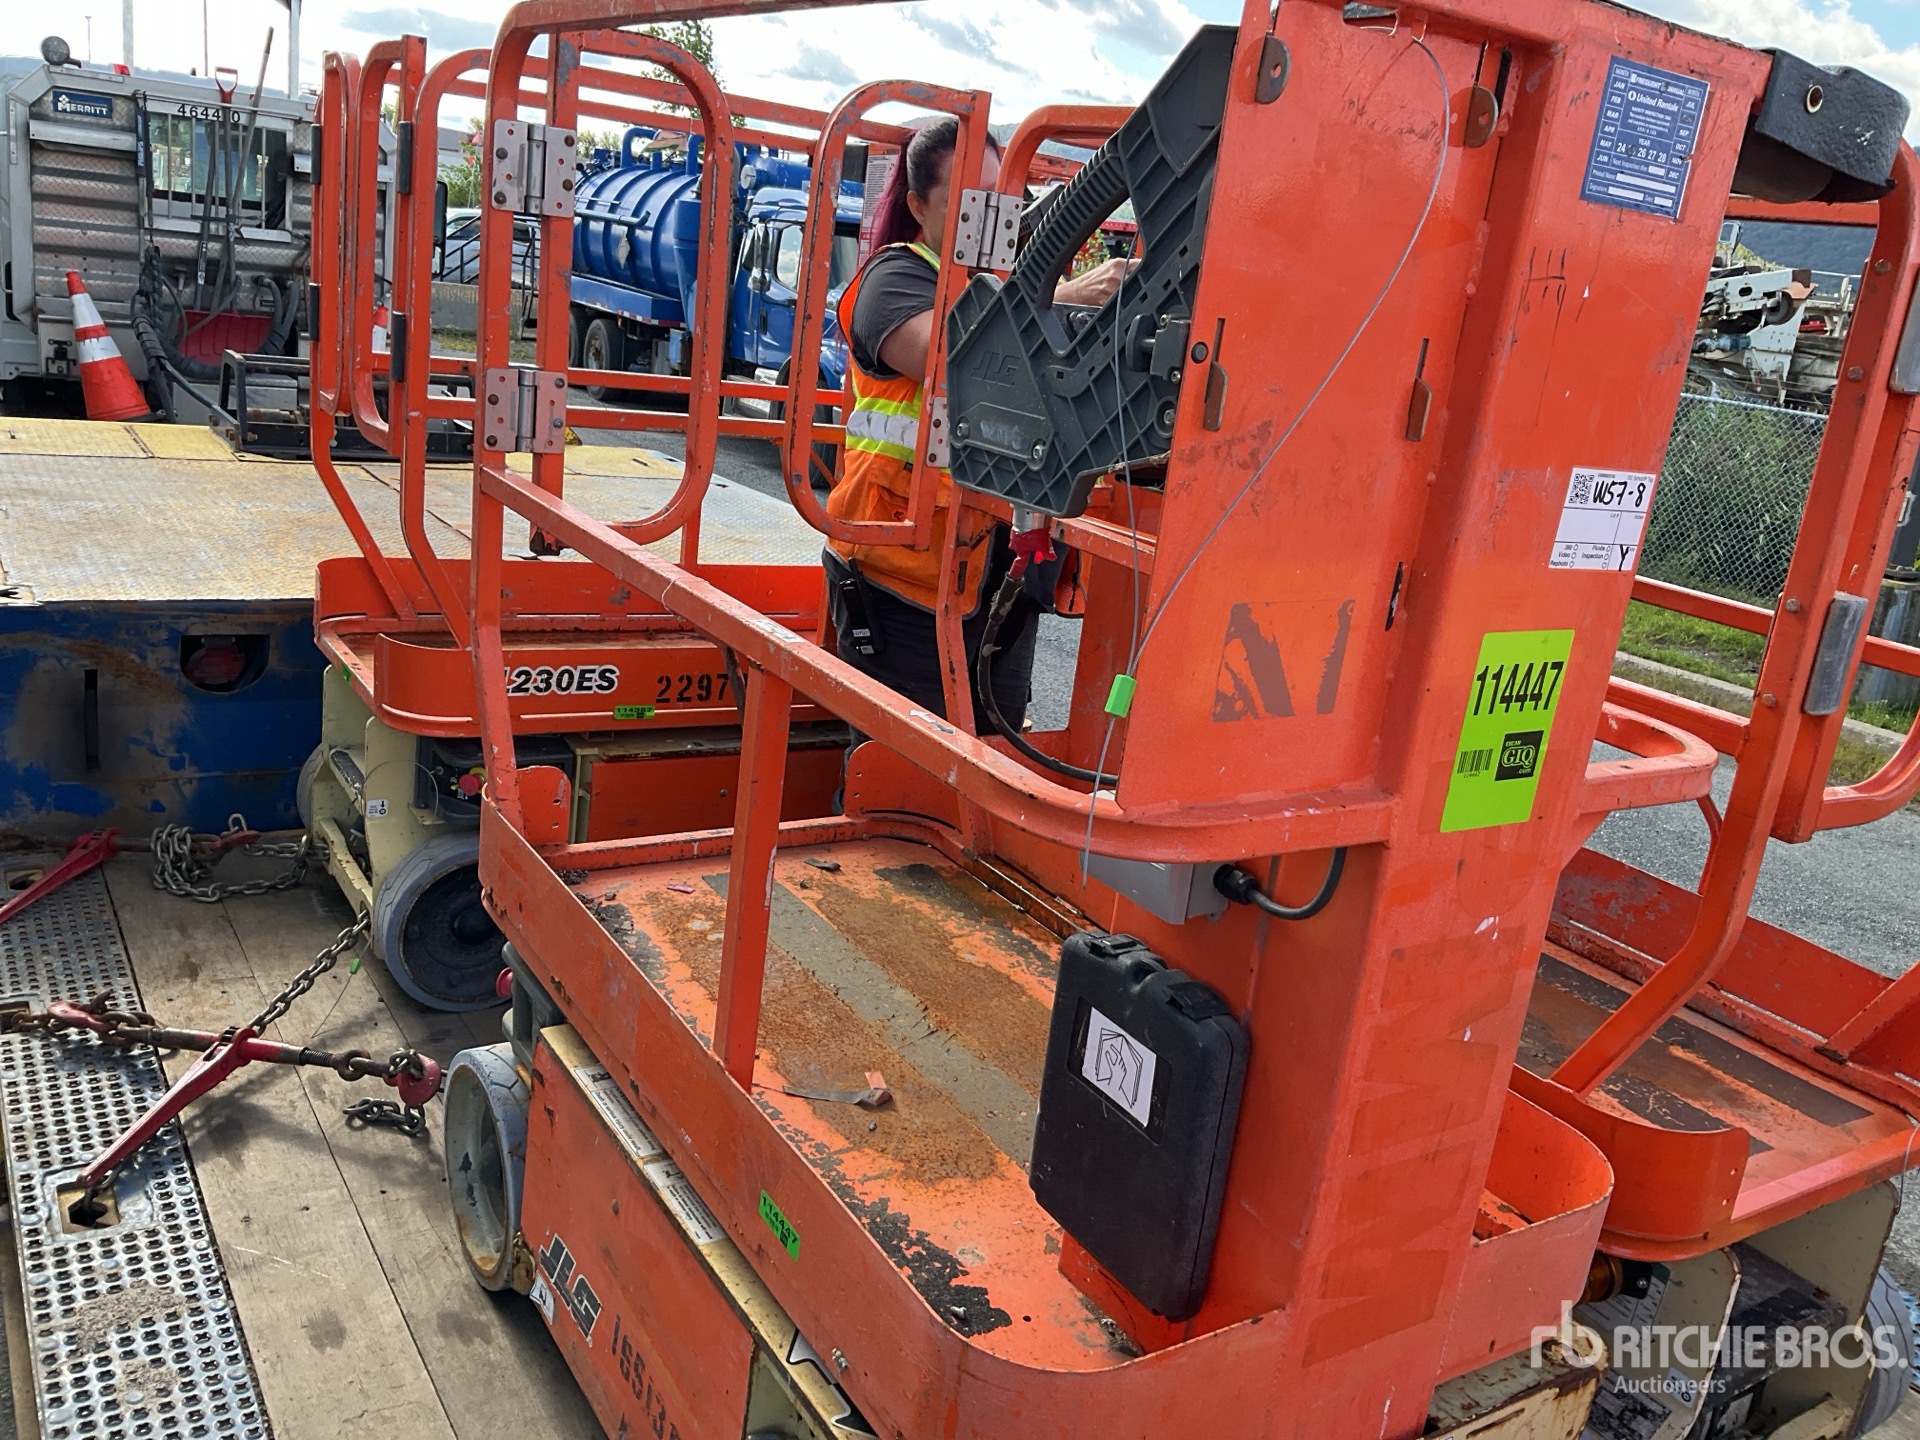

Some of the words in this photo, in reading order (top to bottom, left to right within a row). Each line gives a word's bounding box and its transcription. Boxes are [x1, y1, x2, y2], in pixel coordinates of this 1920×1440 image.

[1613, 80, 1626, 90] JAN
[1610, 95, 1622, 104] FEB
[1636, 92, 1657, 107] United
[1656, 98, 1679, 112] Rentals
[1685, 100, 1696, 109] JUL
[57, 102, 108, 116] MERRITT
[1606, 109, 1620, 119] MAR
[1603, 124, 1616, 134] APR
[1678, 129, 1690, 137] SEP
[1599, 138, 1613, 148] MAY
[1638, 137, 1651, 147] YEAR
[1675, 143, 1686, 151] OCT
[1616, 142, 1626, 153] 24
[1637, 147, 1647, 158] 26
[1647, 149, 1657, 161] 27
[1657, 152, 1667, 163] 28
[1597, 154, 1610, 163] JUN
[1671, 156, 1683, 166] NOV
[1668, 170, 1680, 179] DEC
[1473, 661, 1564, 716] 114447
[1502, 745, 1535, 768] GIQ
[538, 1232, 603, 1343] JLG
